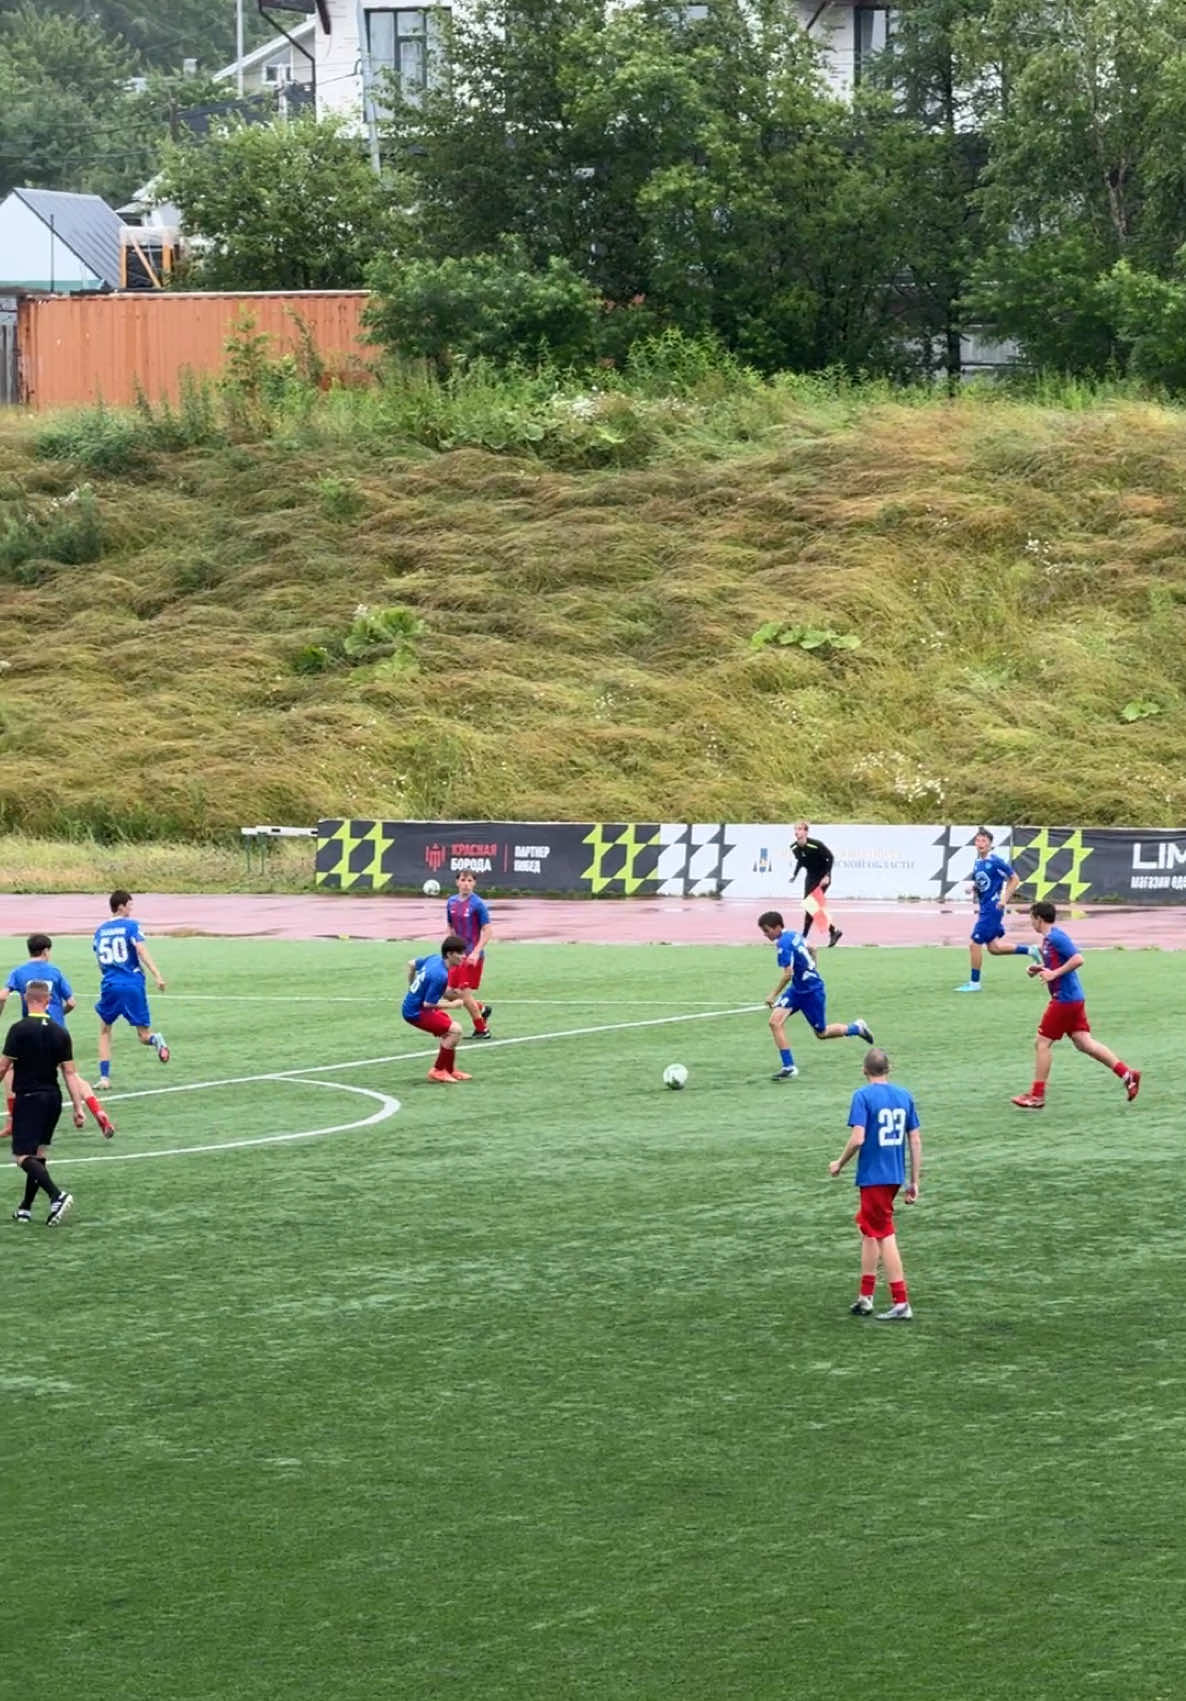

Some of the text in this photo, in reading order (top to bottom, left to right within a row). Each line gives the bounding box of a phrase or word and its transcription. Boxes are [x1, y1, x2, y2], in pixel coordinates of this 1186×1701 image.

[450, 857, 492, 873] БОРОДА
[98, 936, 129, 965] 50
[877, 1107, 907, 1147] 23
